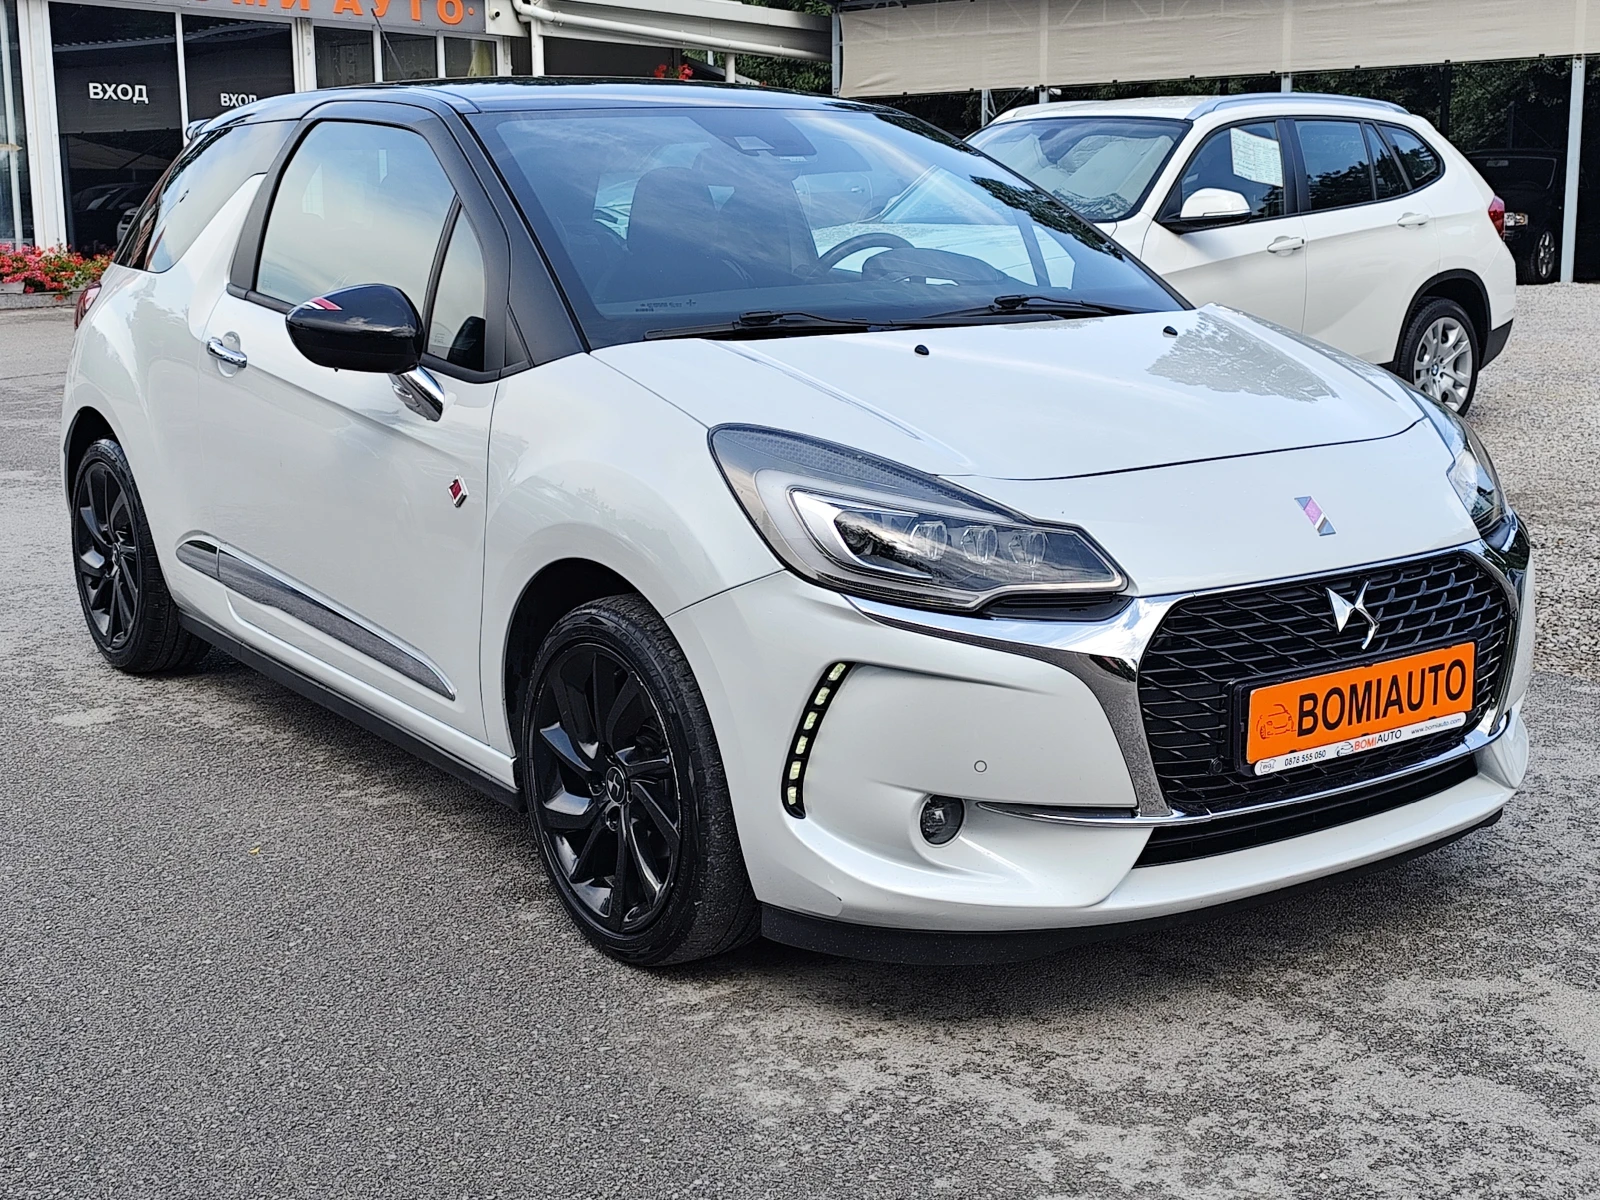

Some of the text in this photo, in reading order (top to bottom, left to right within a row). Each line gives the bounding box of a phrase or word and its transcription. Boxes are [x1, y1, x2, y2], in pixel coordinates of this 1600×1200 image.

[88, 82, 149, 104] ВХОД
[1297, 659, 1467, 737] BOMIAUTO
[1301, 753, 1313, 762] 555
[1314, 750, 1327, 759] 050
[1354, 729, 1402, 751] BOMIAUTO
[1411, 717, 1462, 735] www.bomiauto.com
